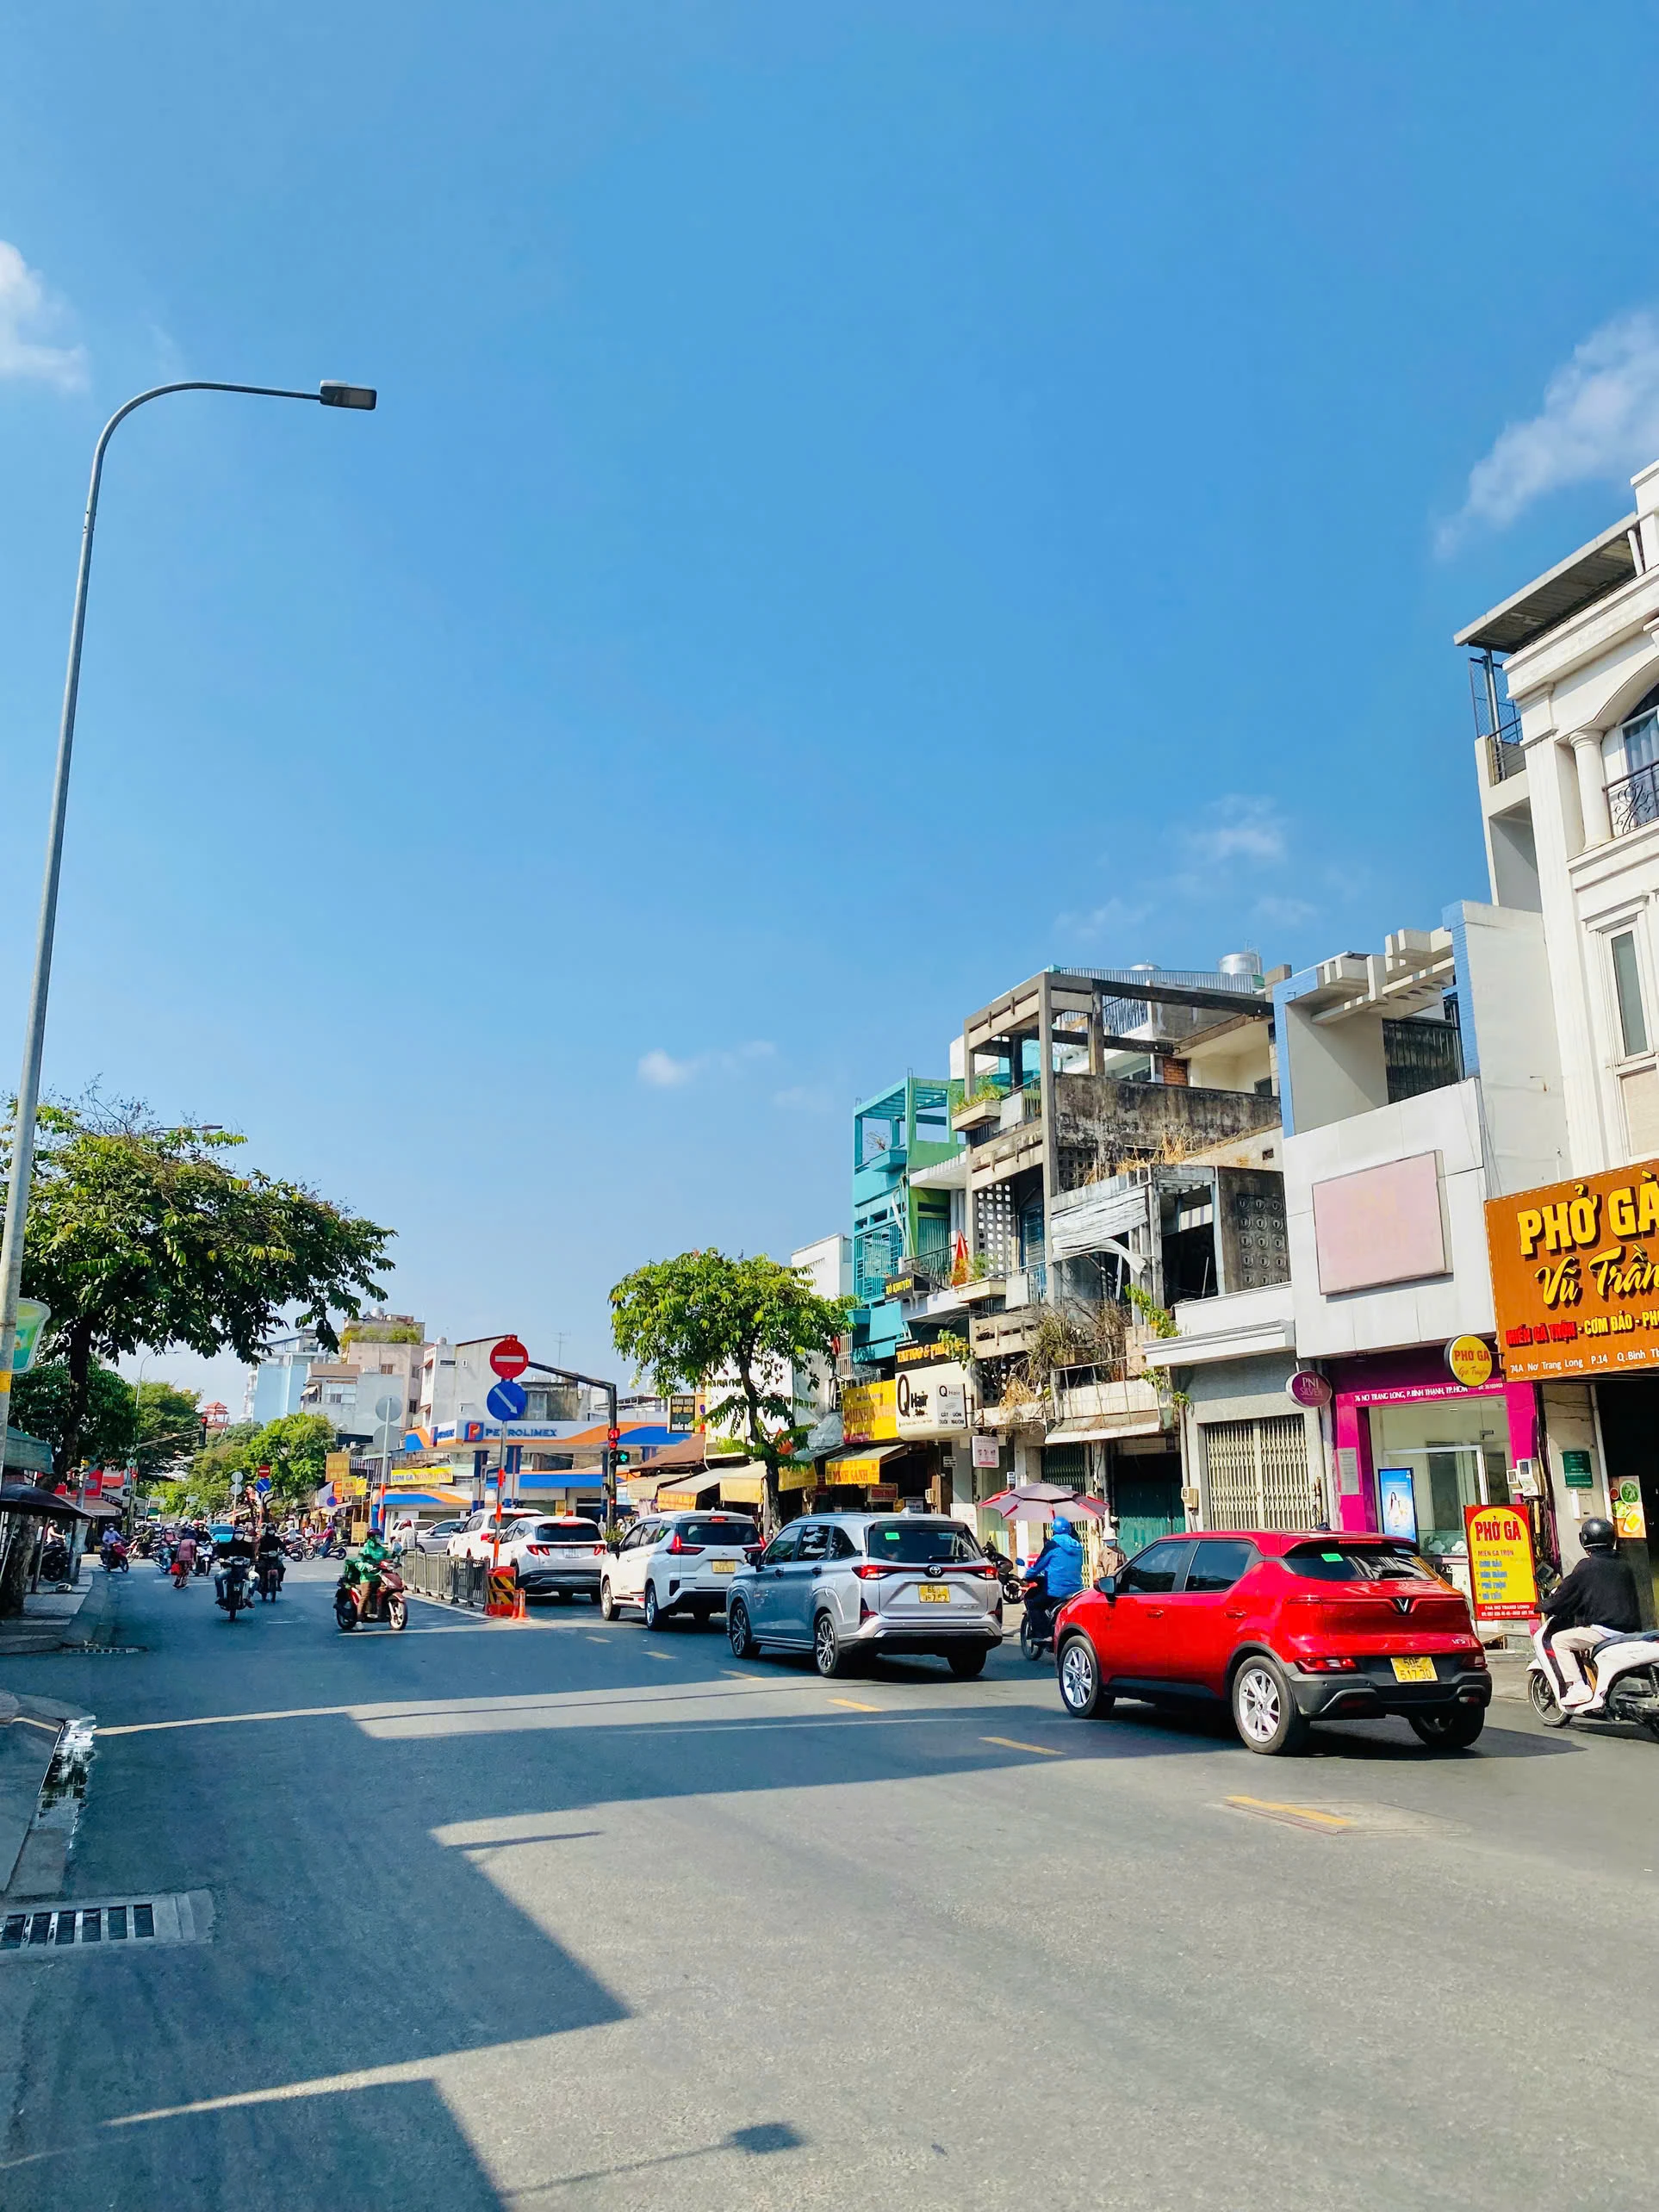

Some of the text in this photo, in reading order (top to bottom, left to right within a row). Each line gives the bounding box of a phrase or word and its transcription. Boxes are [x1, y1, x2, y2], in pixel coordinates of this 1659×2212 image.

[1517, 1170, 1659, 1257] PHỞ GÀ
[1534, 1244, 1659, 1307] Vũ Trần
[1584, 1316, 1609, 1335] CƠM
[1611, 1309, 1633, 1332] ĐẢO
[1510, 1364, 1524, 1373] 74A
[1541, 1361, 1562, 1371] Trang
[1564, 1358, 1584, 1368] Long
[1591, 1354, 1608, 1364] P.14
[939, 1385, 948, 1397] Q
[1302, 1377, 1319, 1389] PNJ
[898, 1374, 910, 1418] Q
[1371, 1392, 1389, 1401] TRANG
[1475, 1516, 1522, 1541] PHỞ GÀ
